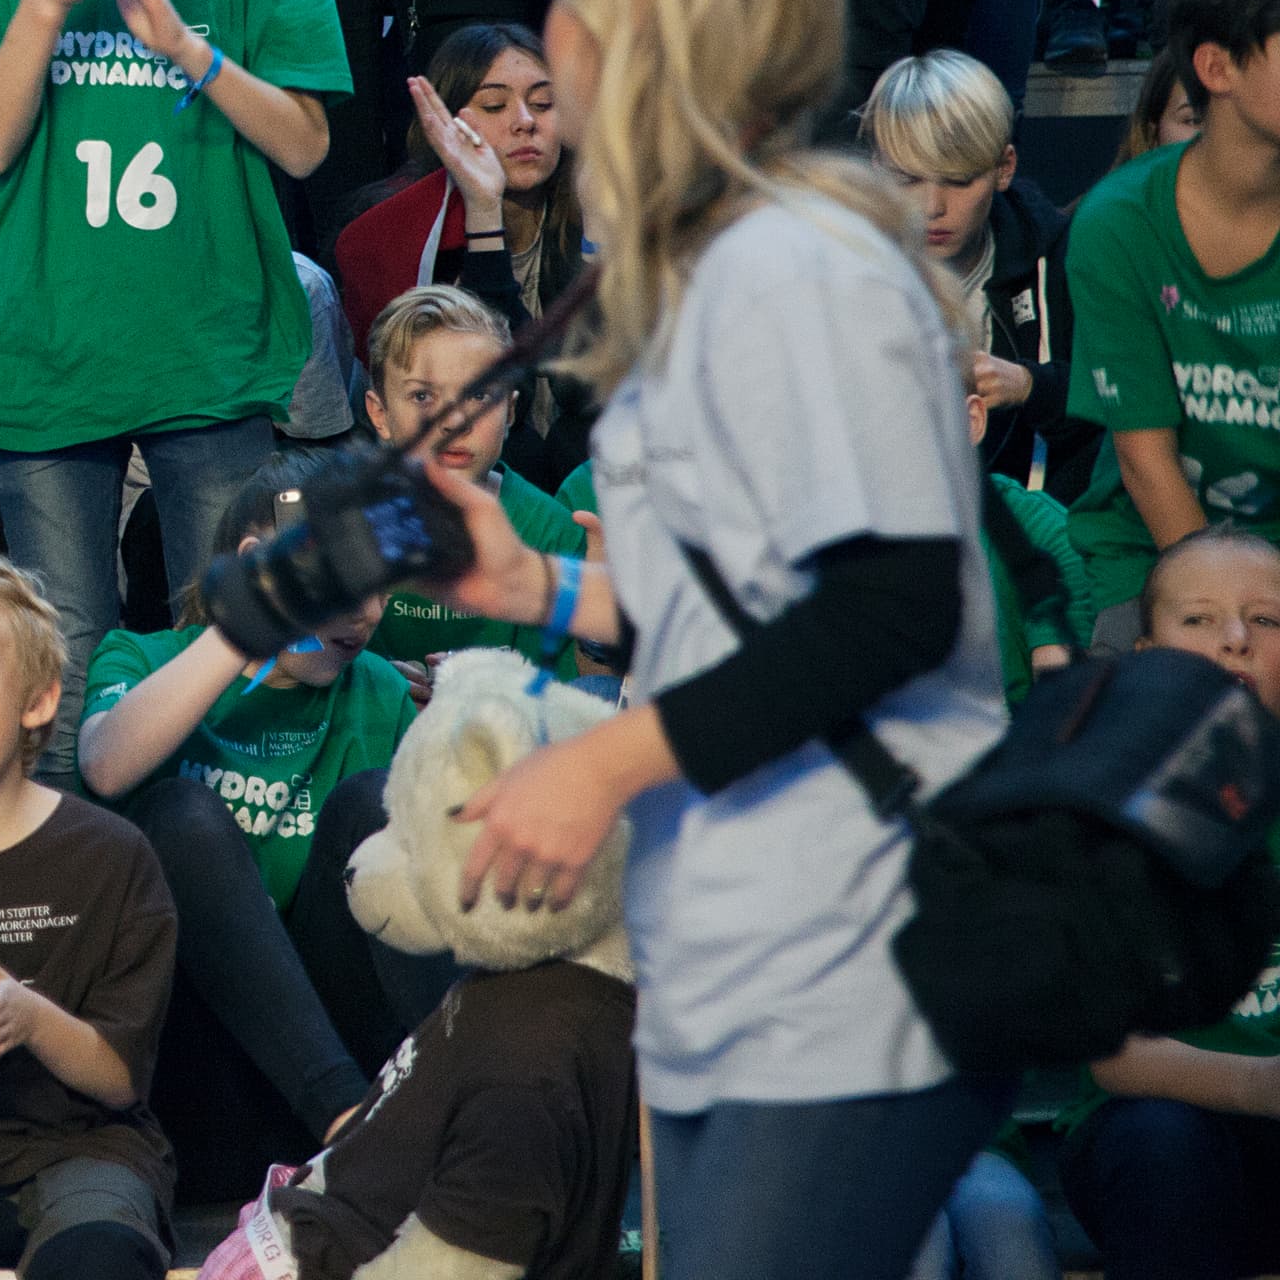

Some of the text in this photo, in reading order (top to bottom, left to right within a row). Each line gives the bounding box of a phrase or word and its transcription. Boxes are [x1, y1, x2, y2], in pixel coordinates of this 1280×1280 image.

[51, 61, 189, 91] DYNAMIC
[75, 139, 178, 231] 16
[1172, 361, 1258, 399] YDRO
[393, 599, 441, 620] Statoil
[8, 905, 50, 919] STØTTER
